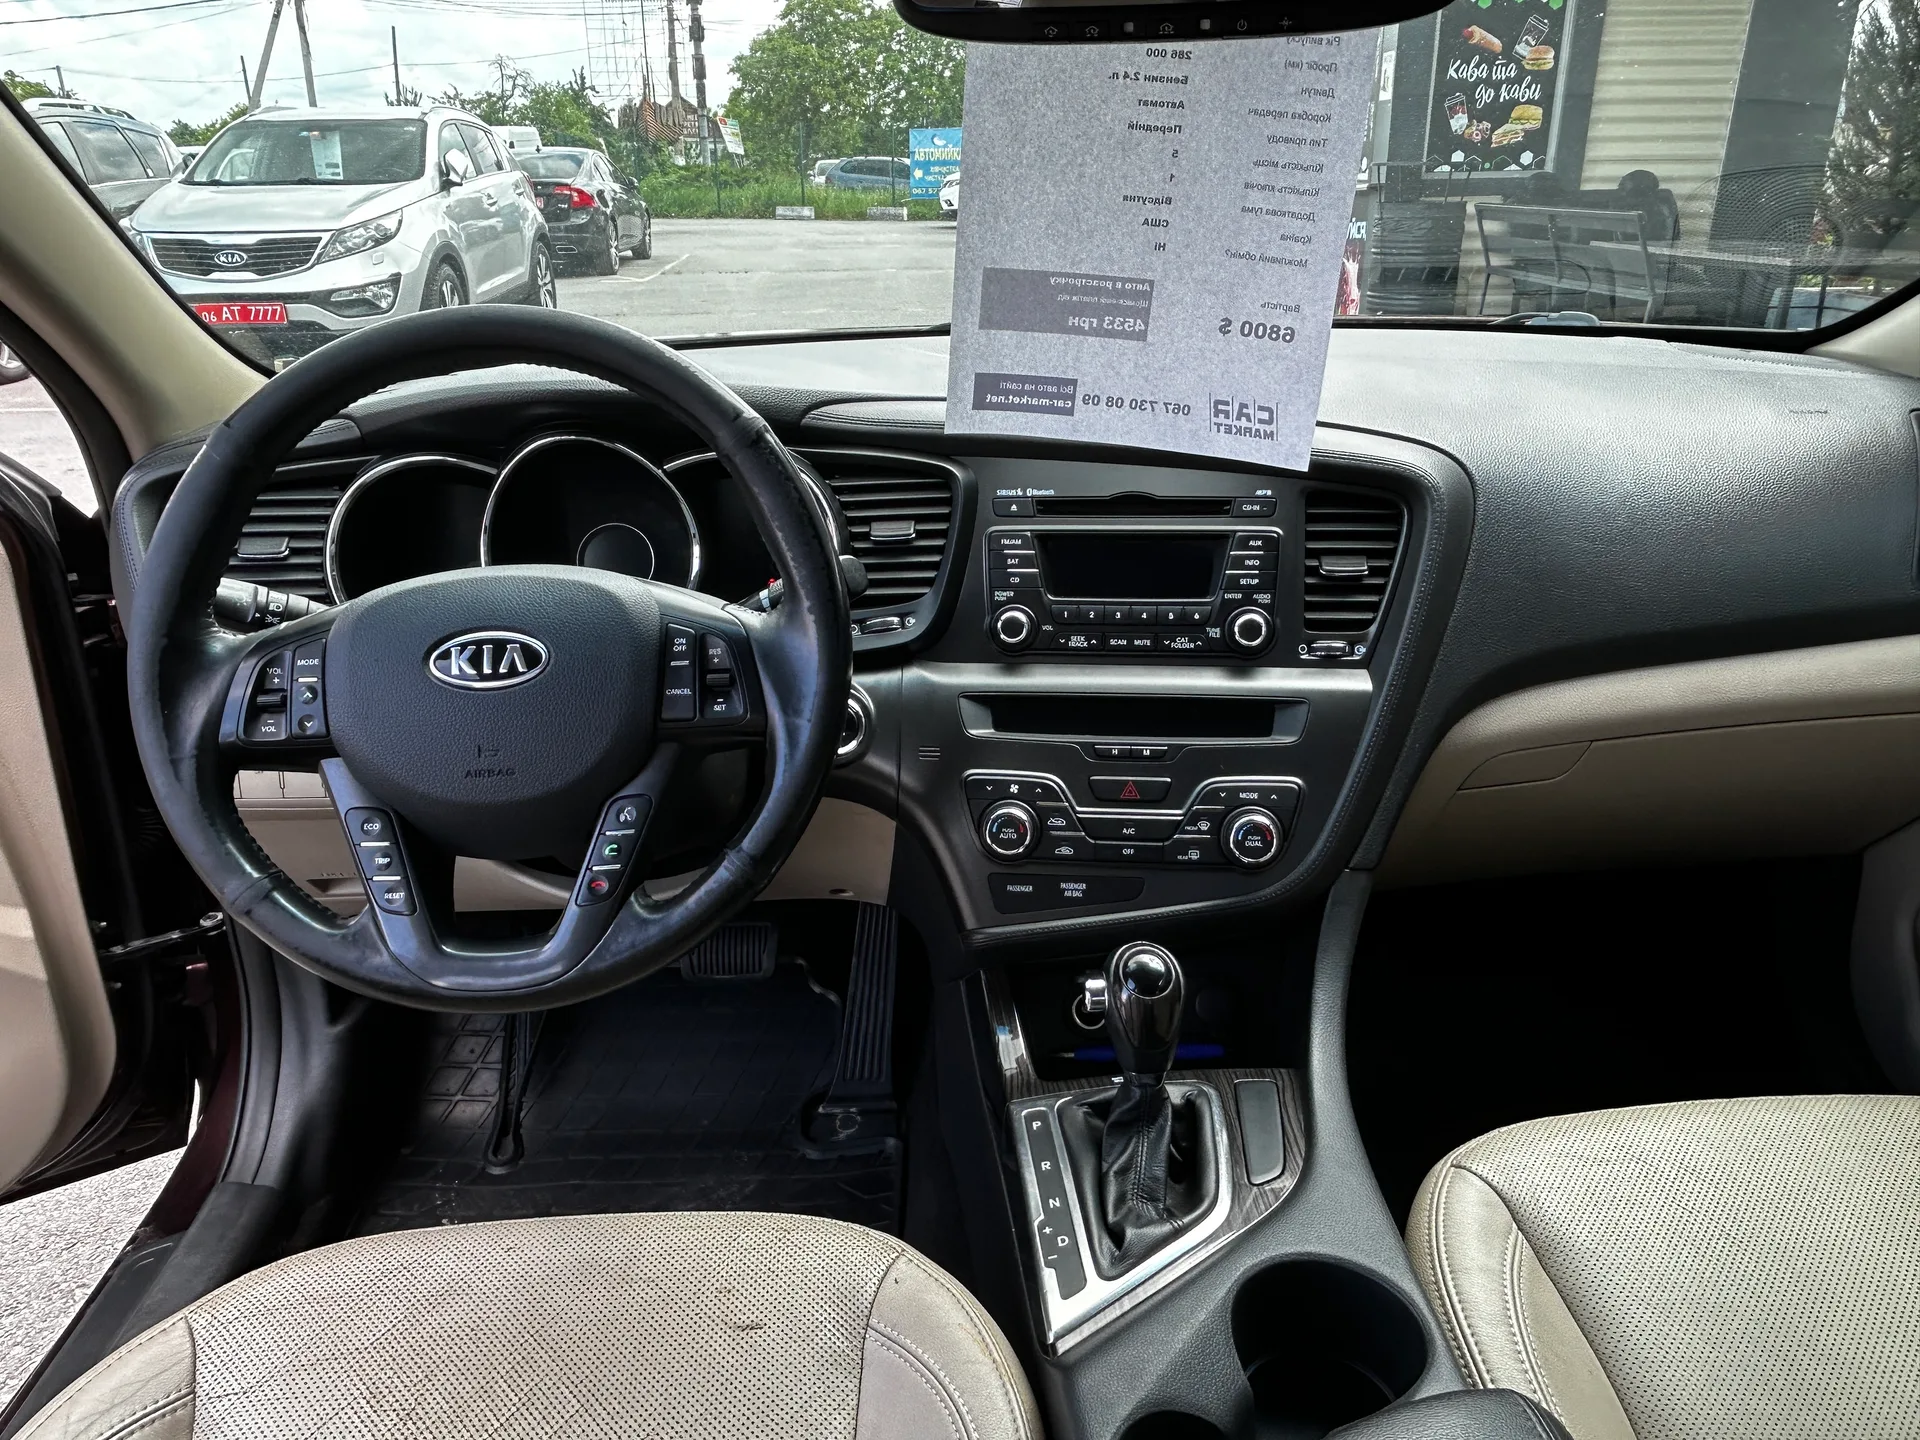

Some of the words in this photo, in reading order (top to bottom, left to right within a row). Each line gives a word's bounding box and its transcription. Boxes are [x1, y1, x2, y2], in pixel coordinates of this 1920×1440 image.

[1447, 54, 1489, 82] Кава
[1475, 81, 1496, 108] до
[1499, 75, 1542, 102] кави
[202, 312, 217, 322] 06
[222, 306, 241, 321] AT
[247, 306, 281, 321] 7777
[1168, 612, 1174, 620] 5
[297, 658, 319, 666] MODE
[449, 643, 528, 677] KIA
[266, 667, 283, 675] VOL
[261, 725, 277, 733] VOL
[464, 768, 516, 779] AIRBAG
[374, 857, 391, 865] TRIP
[1006, 884, 1033, 892] PASSENGER
[1060, 882, 1087, 890] PASSENGER
[1032, 1120, 1041, 1130] P
[1041, 1160, 1051, 1171] R
[1049, 1197, 1061, 1208] N
[1057, 1235, 1069, 1247] D
